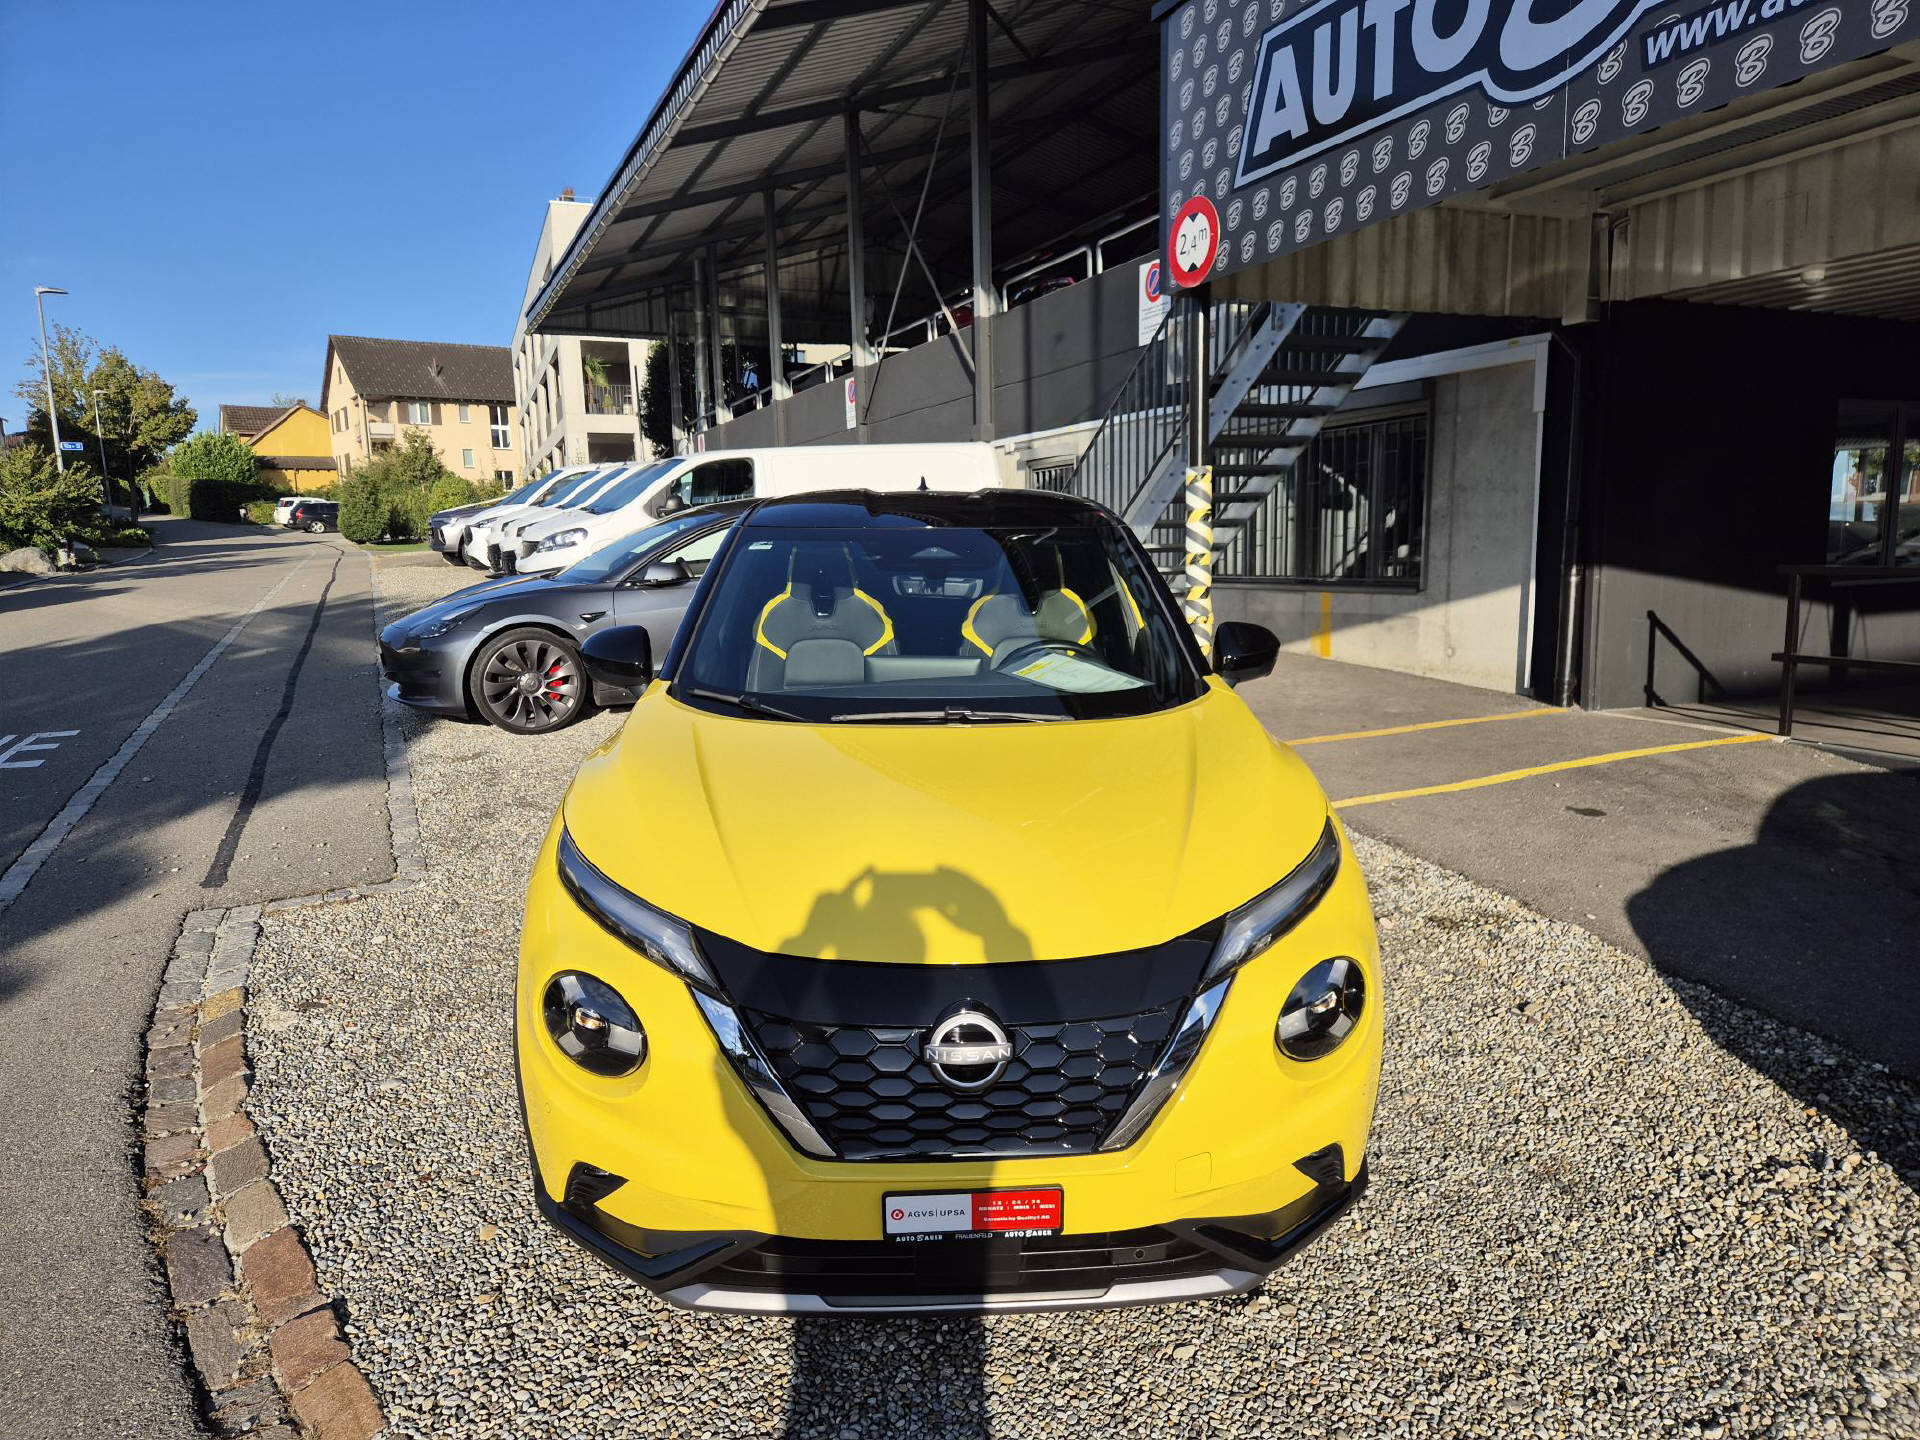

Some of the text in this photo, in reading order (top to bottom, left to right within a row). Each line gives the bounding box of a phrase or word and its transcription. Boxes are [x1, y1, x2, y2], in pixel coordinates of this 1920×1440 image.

[1647, 0, 1808, 64] www.a
[1253, 0, 1491, 157] AUTO
[0, 729, 81, 769] E
[926, 1047, 1011, 1061] NISSAN
[907, 1209, 966, 1218] AGVS UPSA
